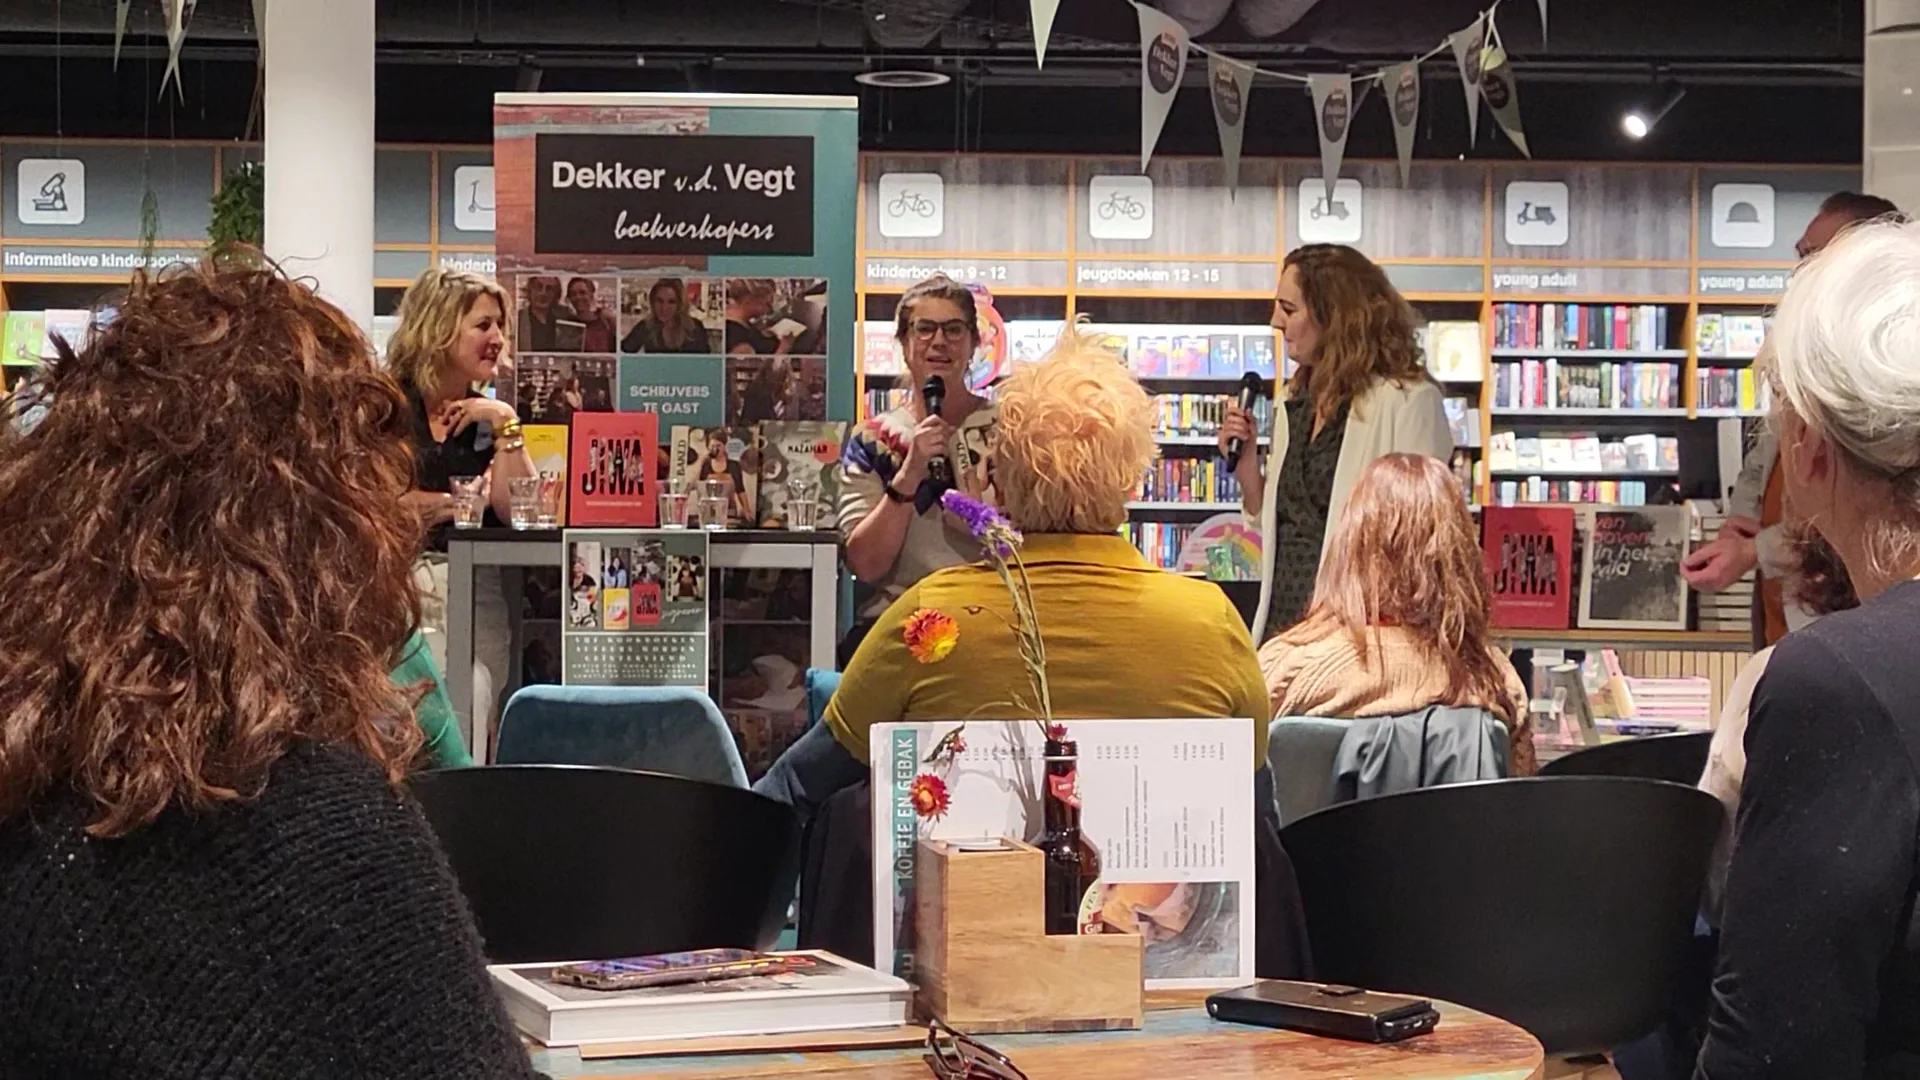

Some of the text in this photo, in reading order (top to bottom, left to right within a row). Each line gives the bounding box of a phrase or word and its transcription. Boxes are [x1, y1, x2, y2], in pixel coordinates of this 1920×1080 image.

[552, 161, 796, 197] Dekker v.d. Vegt
[614, 210, 774, 248] boekverkopers
[4, 252, 99, 267] informatieve
[967, 266, 977, 279] 9
[989, 266, 1007, 280] 12
[1077, 266, 1170, 283] jeugdboeken
[1173, 268, 1190, 281] 12
[1203, 268, 1219, 282] 15
[1493, 272, 1577, 289] young adult
[1700, 276, 1745, 292] young
[1747, 274, 1784, 289] adult
[630, 385, 710, 398] SCHRIJVERS
[643, 402, 700, 414] TE GAST
[1595, 544, 1649, 562] in het
[897, 738, 913, 880] KOFFIE EN GEBAK
